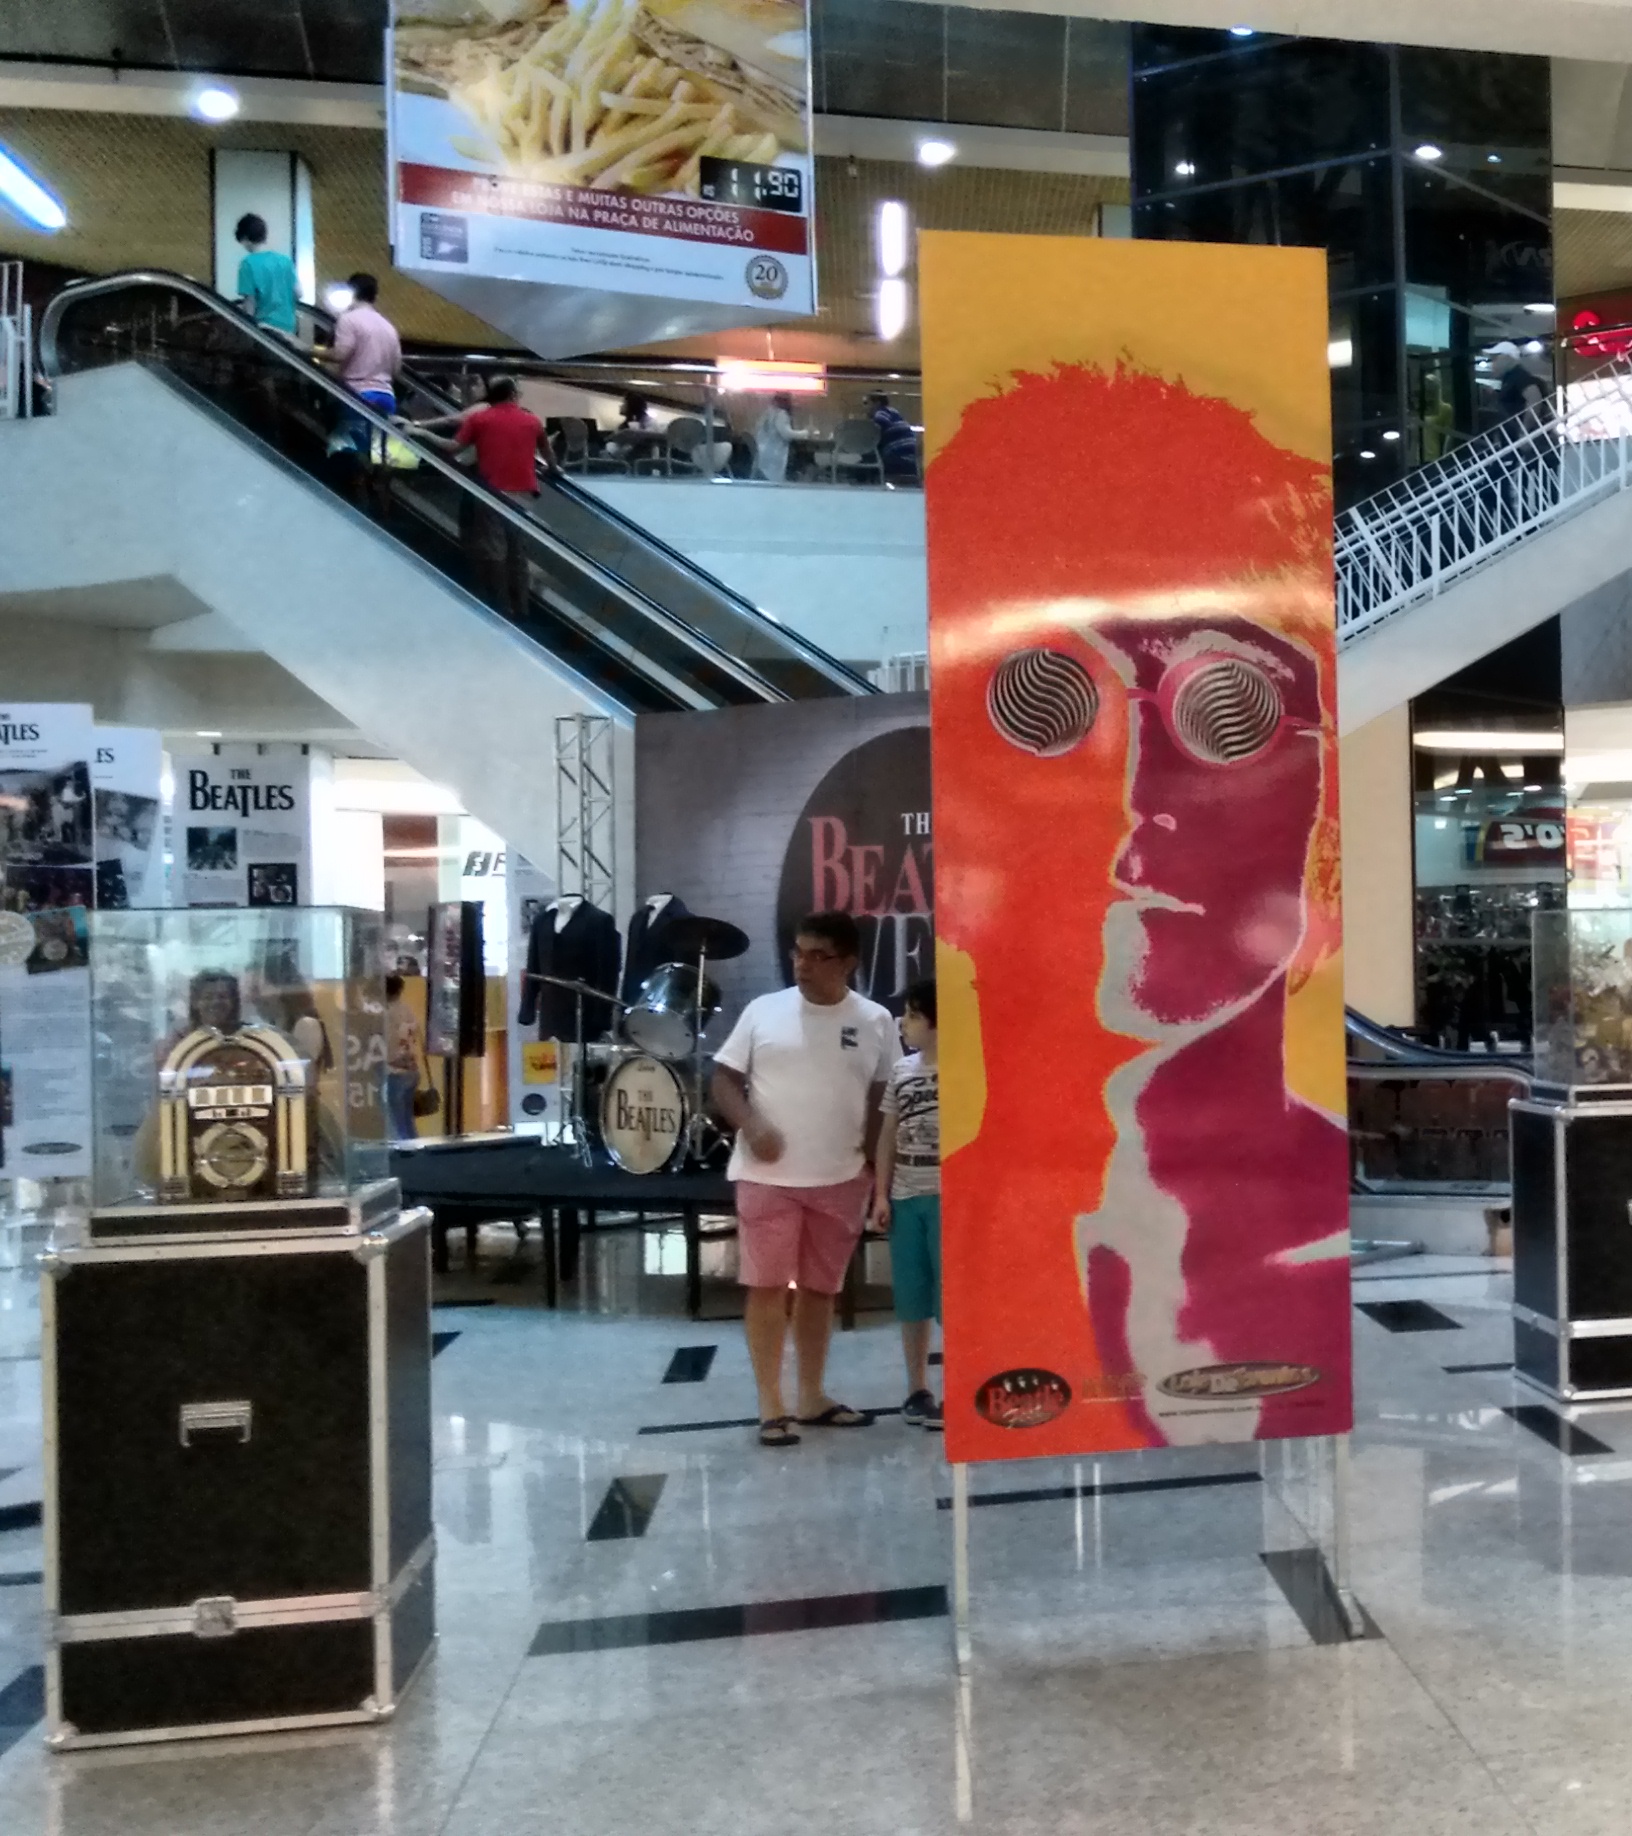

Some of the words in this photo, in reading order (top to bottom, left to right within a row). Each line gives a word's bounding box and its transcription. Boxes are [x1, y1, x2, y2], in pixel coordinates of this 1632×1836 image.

[731, 167, 799, 201] 11.90
[523, 184, 561, 201] ESTAS
[567, 190, 574, 202] E
[579, 192, 626, 210] MUITAS
[631, 199, 684, 217] OUTRAS
[686, 205, 740, 225] OPÇÕES
[531, 201, 564, 218] LOJA
[569, 207, 590, 222] NA
[594, 209, 639, 228] PRAÇA
[642, 217, 659, 230] DE
[663, 219, 755, 242] ALIMENTAÇÃO
[754, 264, 778, 282] 20
[230, 768, 252, 780] THE
[189, 769, 295, 817] BEATLES
[901, 812, 931, 836] TH
[616, 1088, 676, 1142] BEATLES
